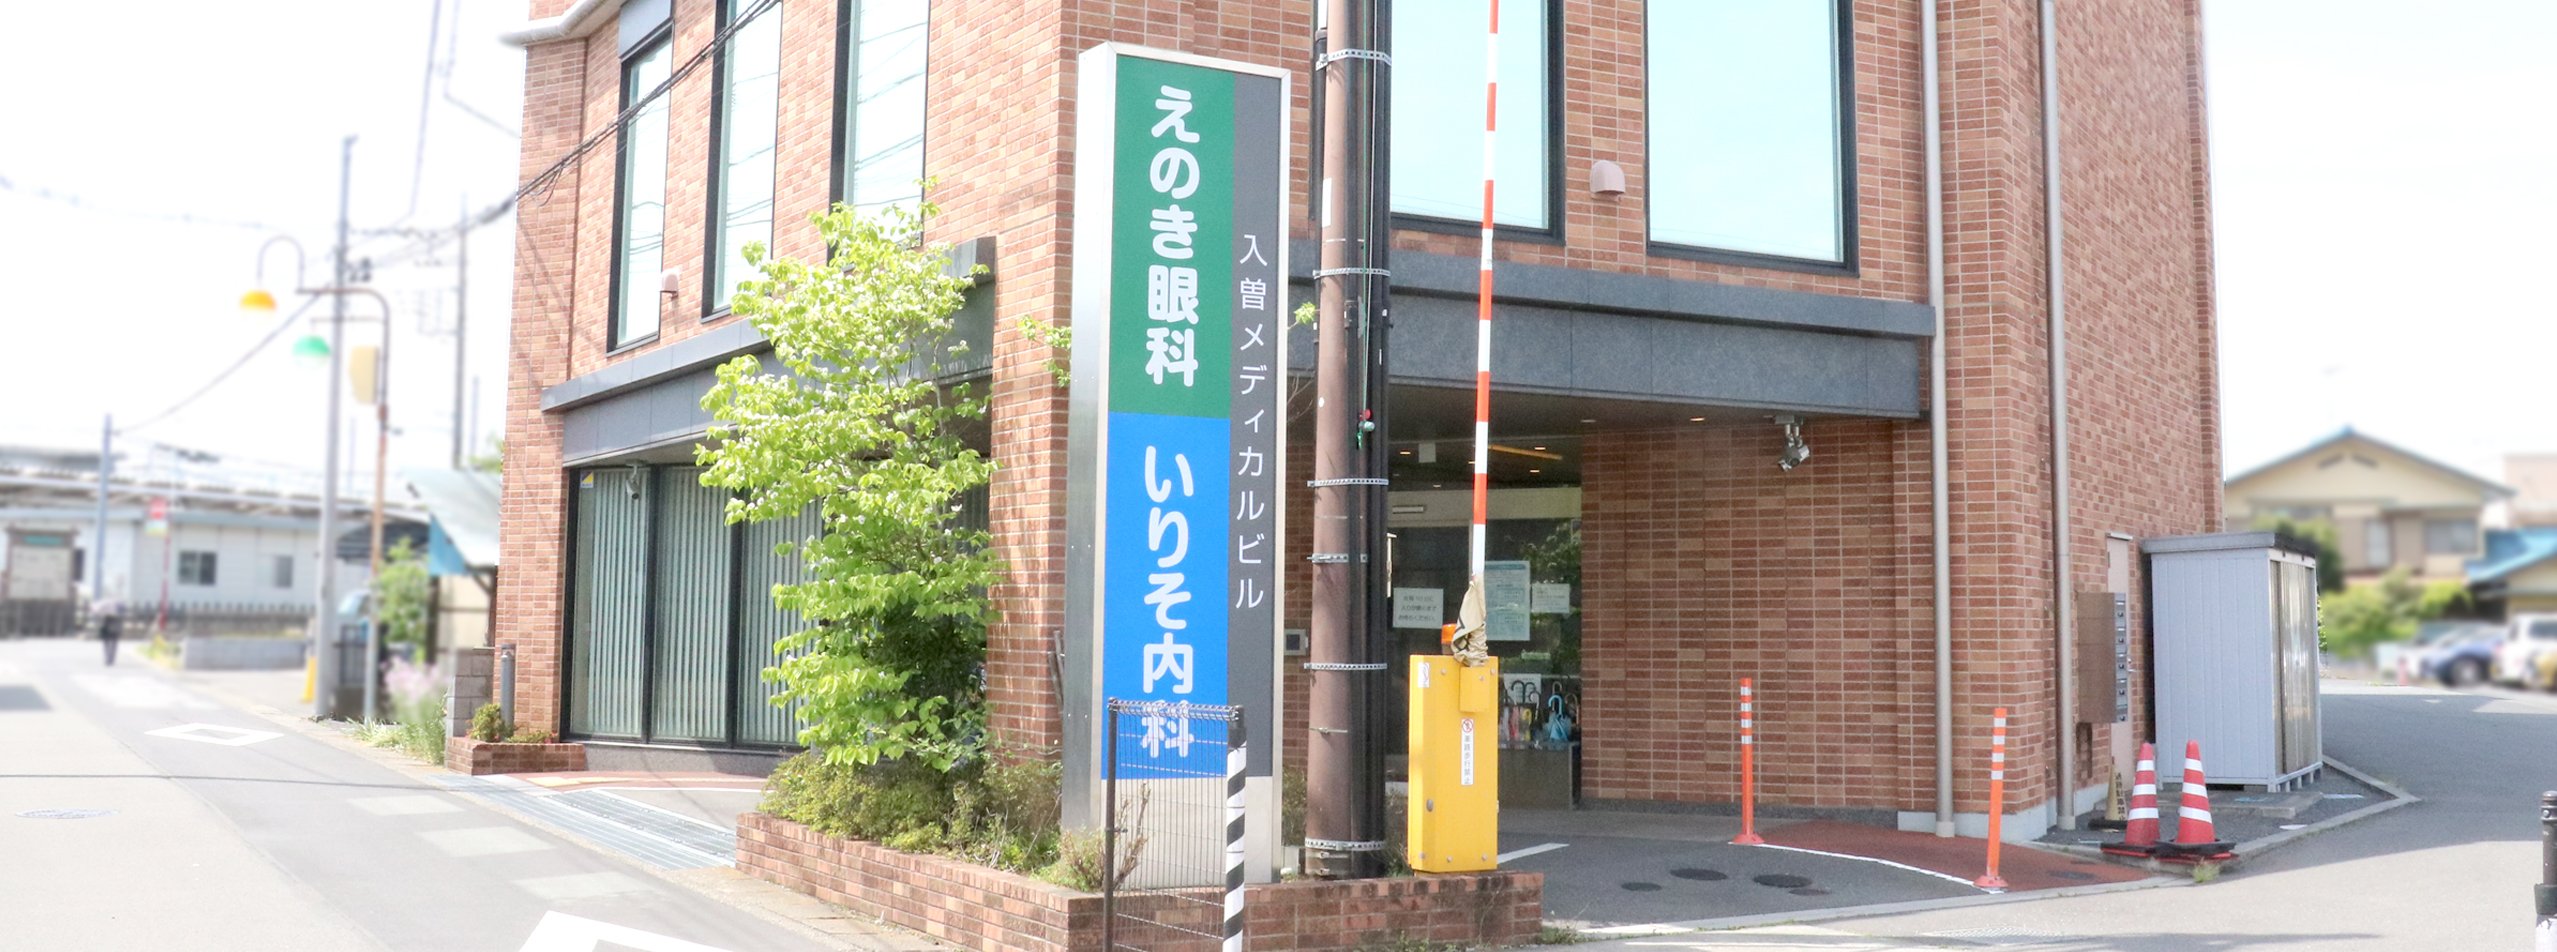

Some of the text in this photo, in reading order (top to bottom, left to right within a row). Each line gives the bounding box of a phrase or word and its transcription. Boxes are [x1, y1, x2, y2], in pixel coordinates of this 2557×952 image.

[1145, 85, 1200, 387] えのき眼科
[1235, 233, 1268, 609] 入曽メディカルビル
[1142, 446, 1194, 758] いりそ内科
